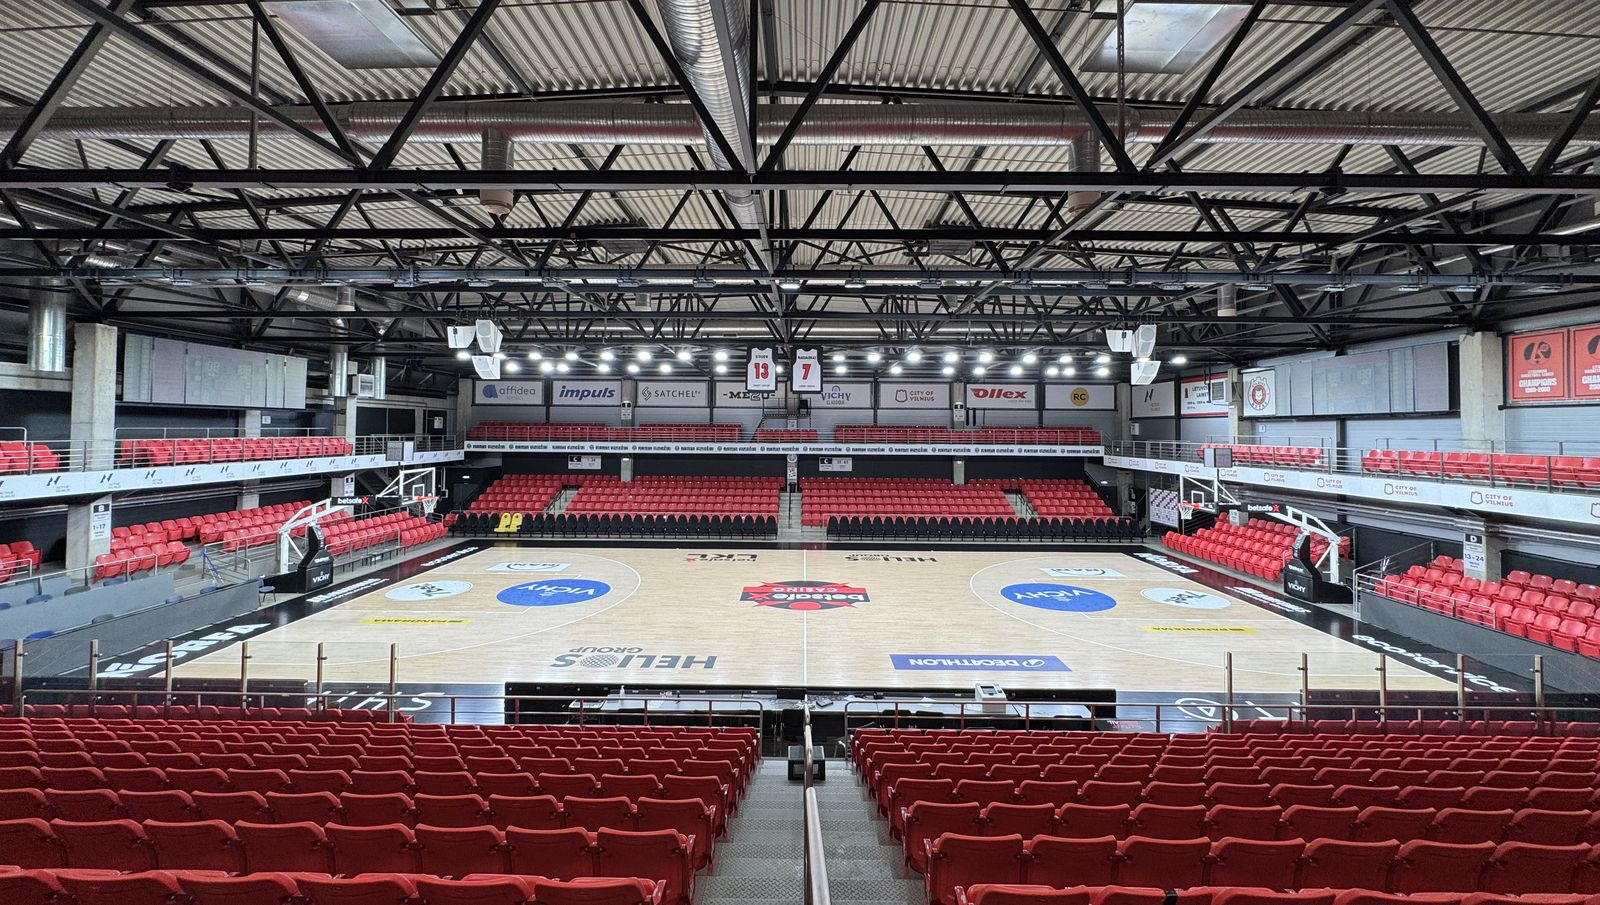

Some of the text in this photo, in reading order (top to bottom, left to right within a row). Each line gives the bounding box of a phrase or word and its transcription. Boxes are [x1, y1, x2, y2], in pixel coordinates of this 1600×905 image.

[754, 362, 769, 380] 13
[802, 363, 811, 380] 7
[499, 385, 536, 395] affidea
[559, 385, 615, 400] impuls
[654, 390, 696, 398] SATCHEL
[971, 388, 1027, 399] Ollex
[821, 392, 851, 400] VICHY
[1073, 393, 1086, 401] RC
[1485, 499, 1514, 507] VILNIUS
[1464, 553, 1484, 561] 13-24
[312, 572, 330, 583] VICHY
[517, 583, 595, 596] VICHY
[1287, 581, 1306, 593] VICHY
[772, 593, 865, 601] betsafe
[1014, 588, 1093, 600] VICHY
[550, 653, 717, 669] HELIOS
[908, 658, 1022, 667] DECATHLON
